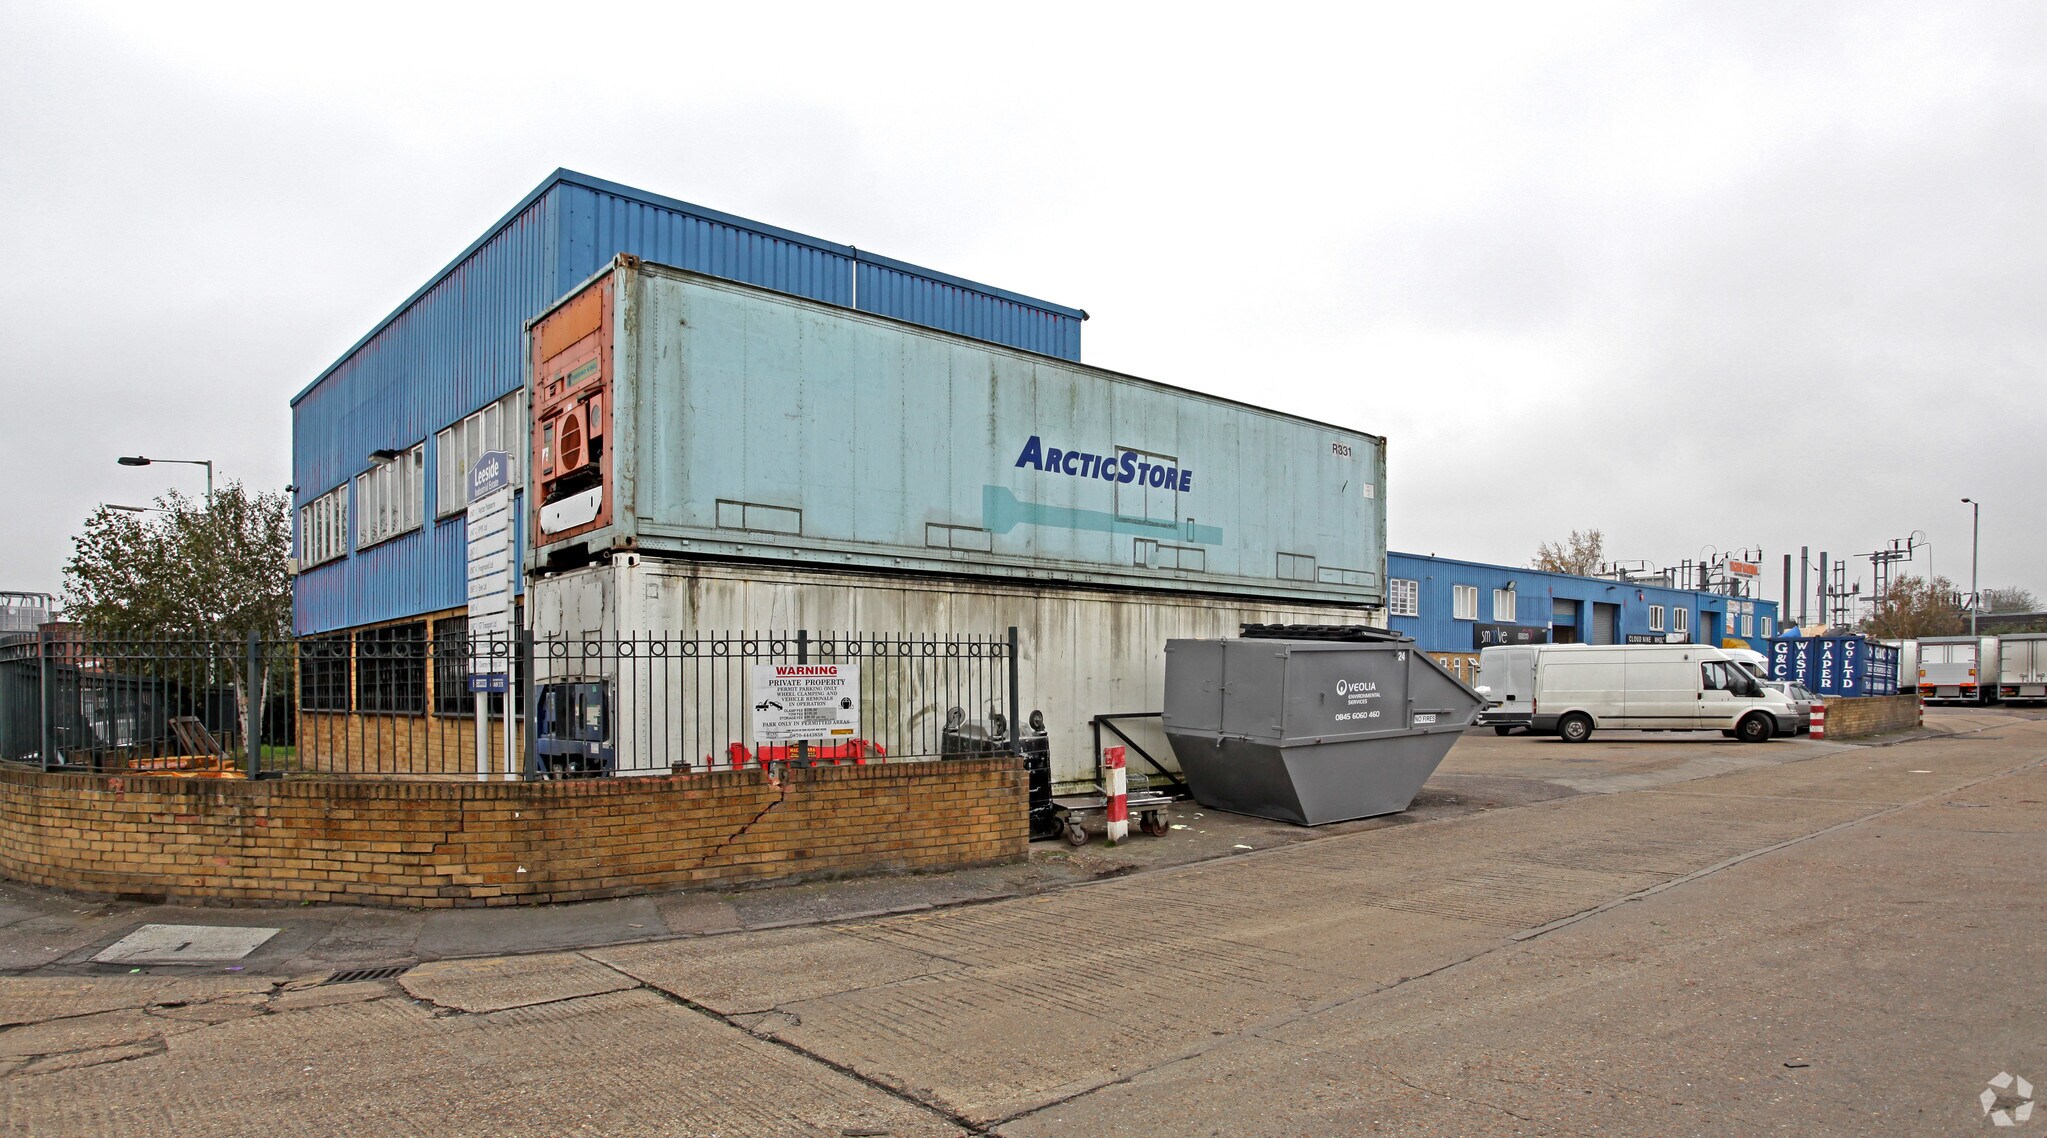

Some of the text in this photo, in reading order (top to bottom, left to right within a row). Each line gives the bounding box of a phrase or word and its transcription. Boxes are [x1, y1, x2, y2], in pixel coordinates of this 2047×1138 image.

[1332, 444, 1352, 457] R331
[474, 458, 499, 486] Leeside
[1398, 652, 1405, 661] 24
[1821, 642, 1832, 687] PAPER
[776, 666, 837, 675] WARNING
[1348, 682, 1376, 692] VEOLIA
